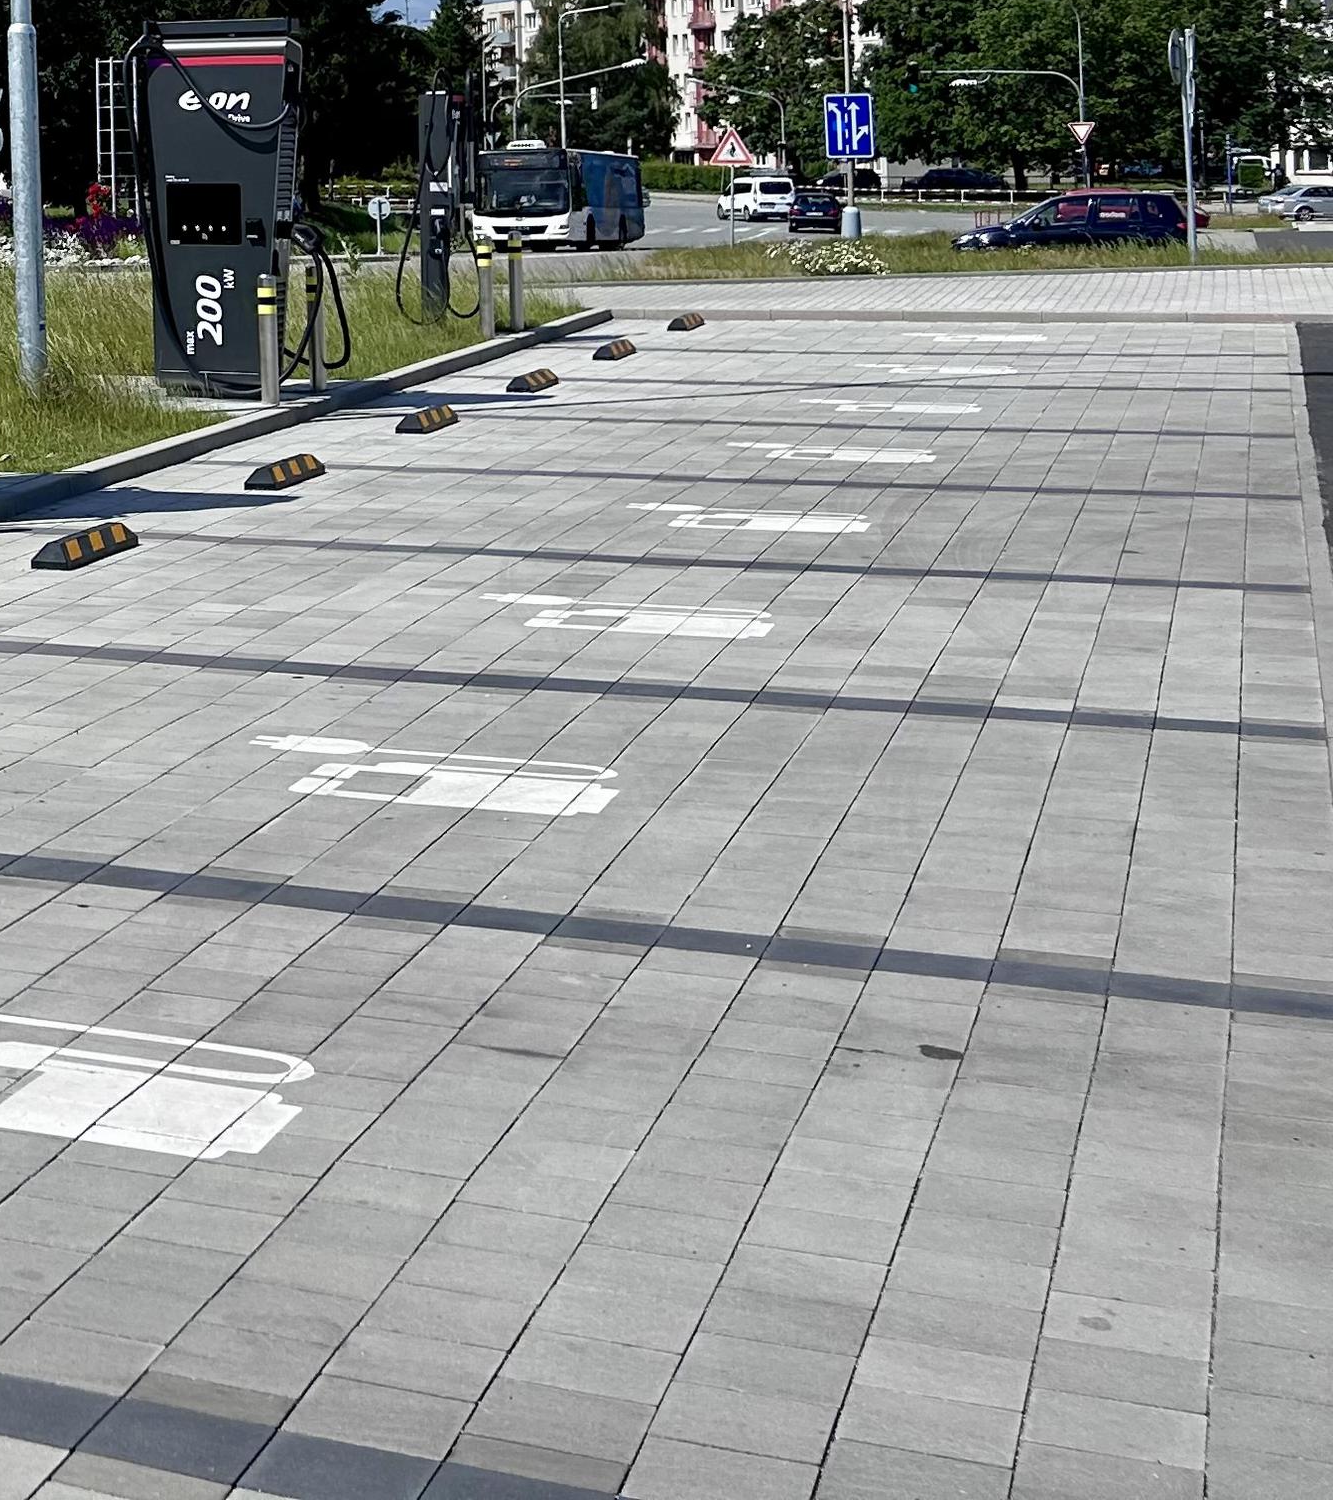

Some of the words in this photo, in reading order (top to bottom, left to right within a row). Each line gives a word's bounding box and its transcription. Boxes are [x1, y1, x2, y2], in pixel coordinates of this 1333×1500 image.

[178, 89, 251, 111] eon
[222, 268, 235, 289] kW
[195, 274, 223, 346] 200
[186, 330, 195, 355] max
